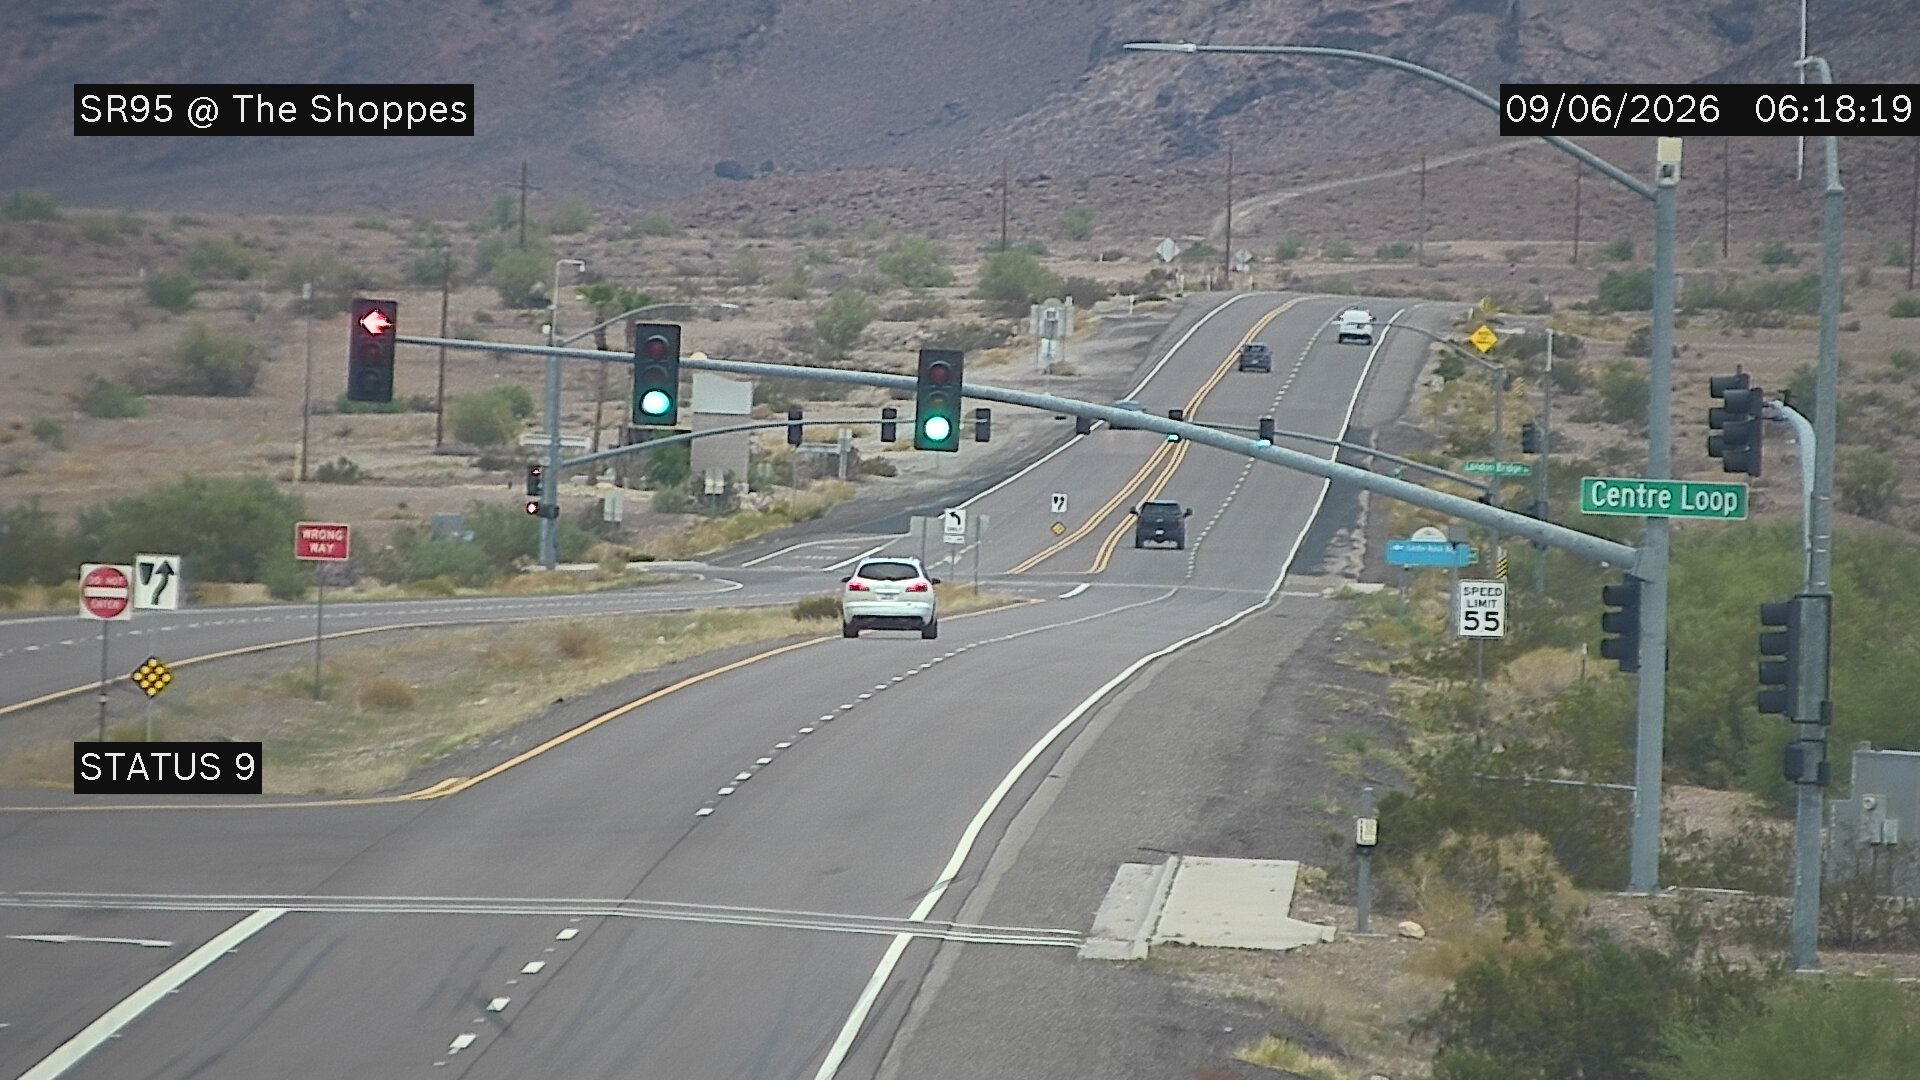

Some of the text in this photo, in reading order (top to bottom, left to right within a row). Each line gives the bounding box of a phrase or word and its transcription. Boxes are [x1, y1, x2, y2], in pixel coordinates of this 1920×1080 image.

[1591, 480, 1738, 516] Centre Loop
[302, 528, 343, 541] WRONG
[309, 542, 335, 554] WAY
[88, 576, 124, 585] DO NOT
[1464, 587, 1503, 597] SPEED
[91, 599, 119, 609] ENTER
[1467, 599, 1498, 608] LIMIT
[1464, 611, 1500, 632] 55
